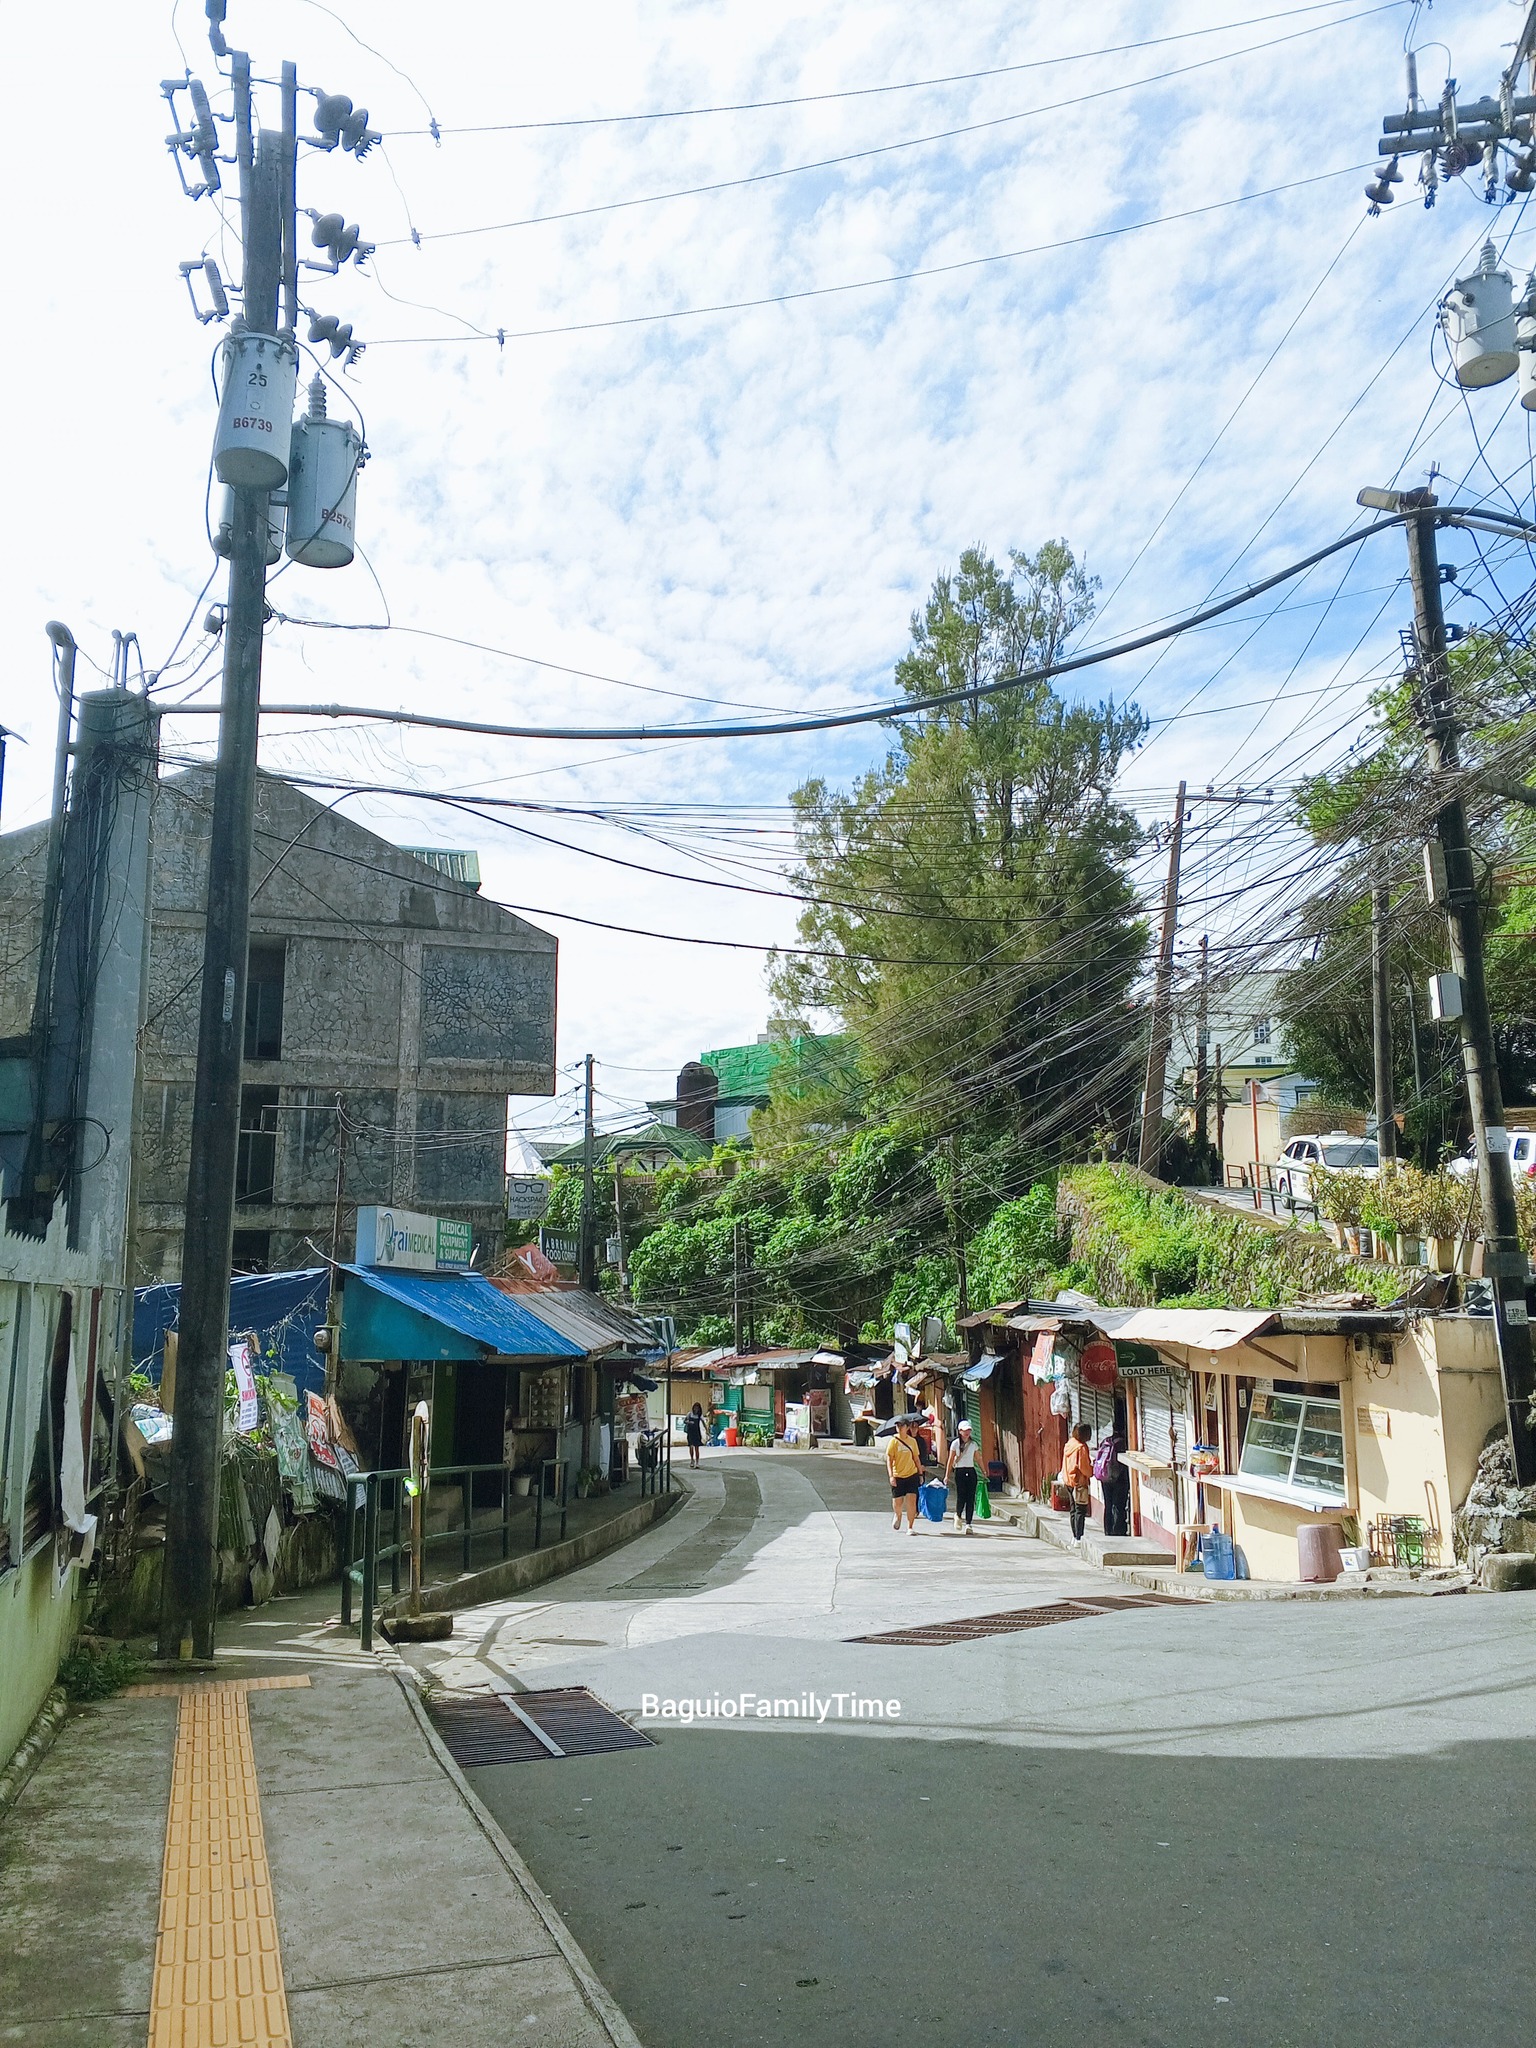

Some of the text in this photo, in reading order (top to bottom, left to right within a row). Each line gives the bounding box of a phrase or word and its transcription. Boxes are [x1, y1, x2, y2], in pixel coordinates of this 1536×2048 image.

[248, 373, 267, 387] 25
[233, 416, 273, 433] B6739
[440, 1221, 468, 1237] MEDICAL
[440, 1235, 468, 1249] EQUIPMENT
[444, 1248, 468, 1261] SUPPLIES
[546, 1249, 561, 1261] FOOD
[1121, 1366, 1171, 1376] LOAD HERE
